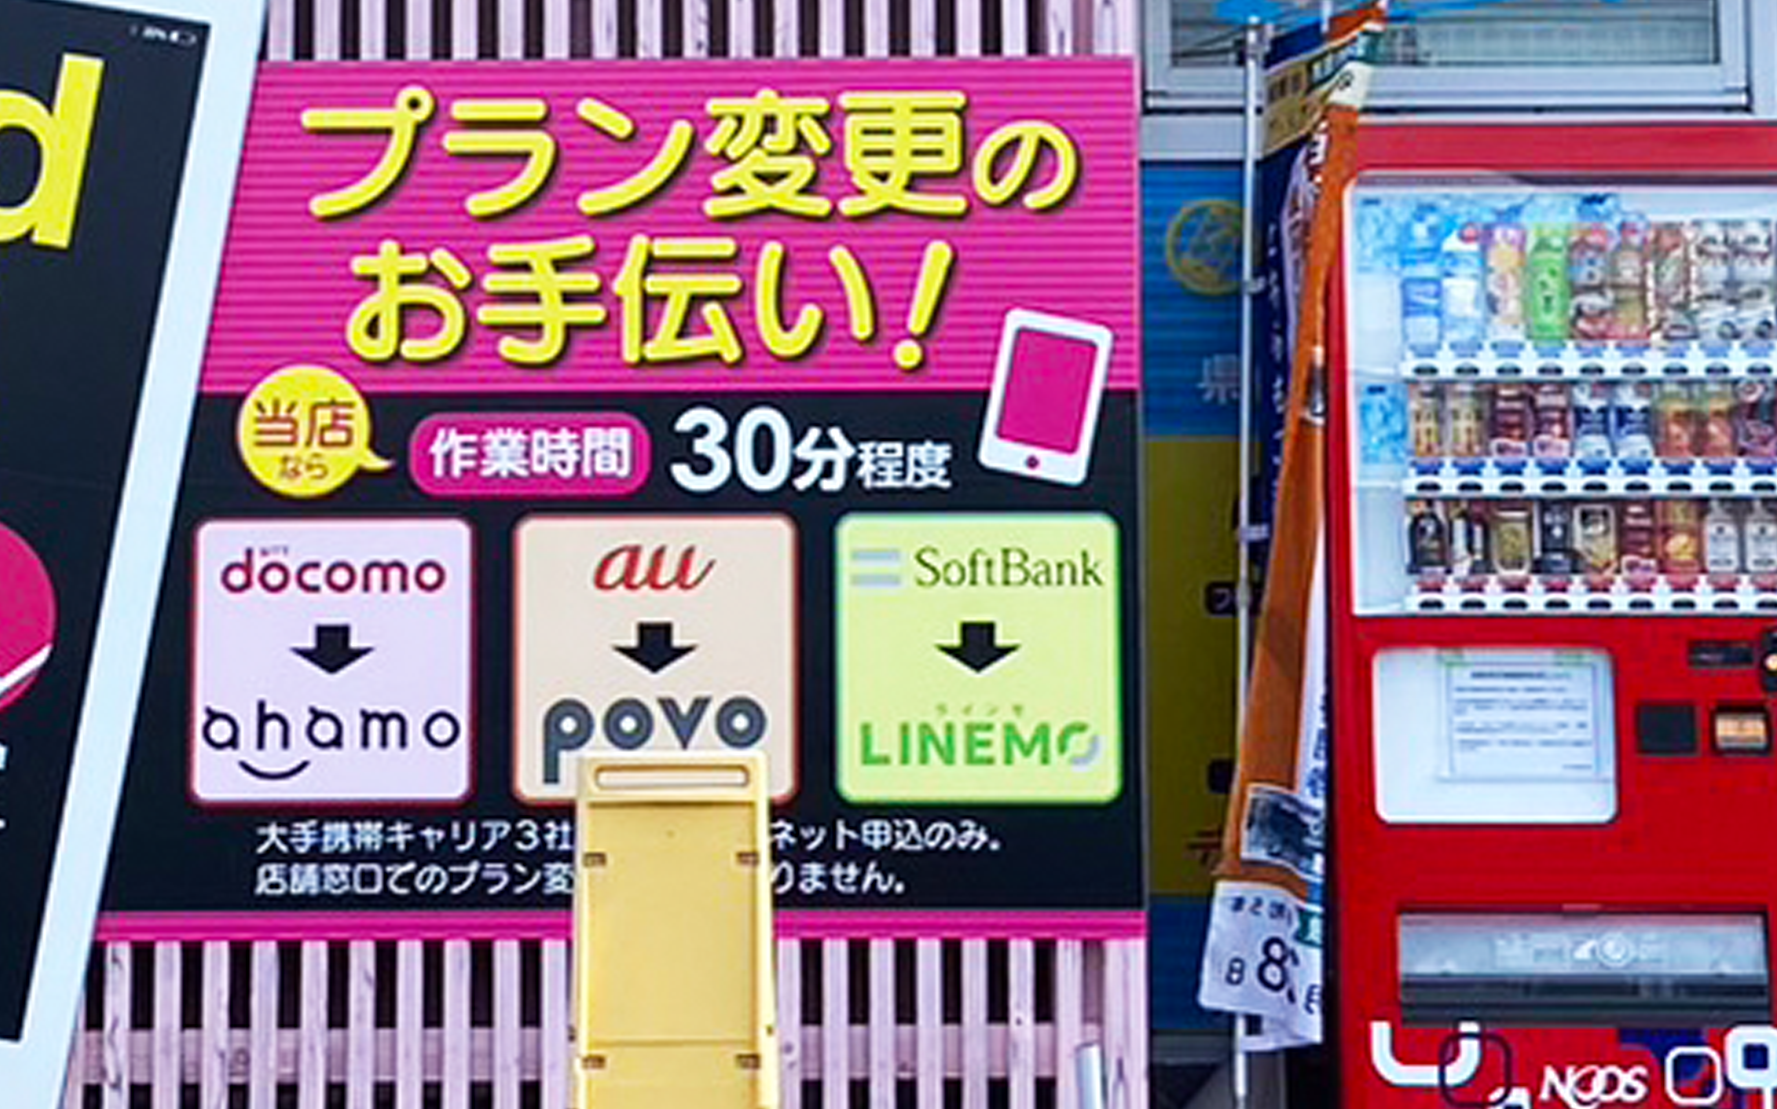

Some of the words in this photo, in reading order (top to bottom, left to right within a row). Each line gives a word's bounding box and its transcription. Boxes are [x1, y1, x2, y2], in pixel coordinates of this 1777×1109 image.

[301, 86, 1080, 217] プラン変更の
[344, 235, 955, 369] お手伝い!
[254, 398, 356, 450] 当店
[430, 428, 630, 479] 作業時間
[671, 406, 951, 491] 30分程度
[279, 450, 329, 482] なら
[221, 547, 446, 593] docomo
[592, 541, 716, 593] au
[914, 546, 1104, 587] SoftBank
[202, 699, 460, 750] ahamo
[542, 696, 768, 784] povo
[860, 721, 1102, 768] LINEMO
